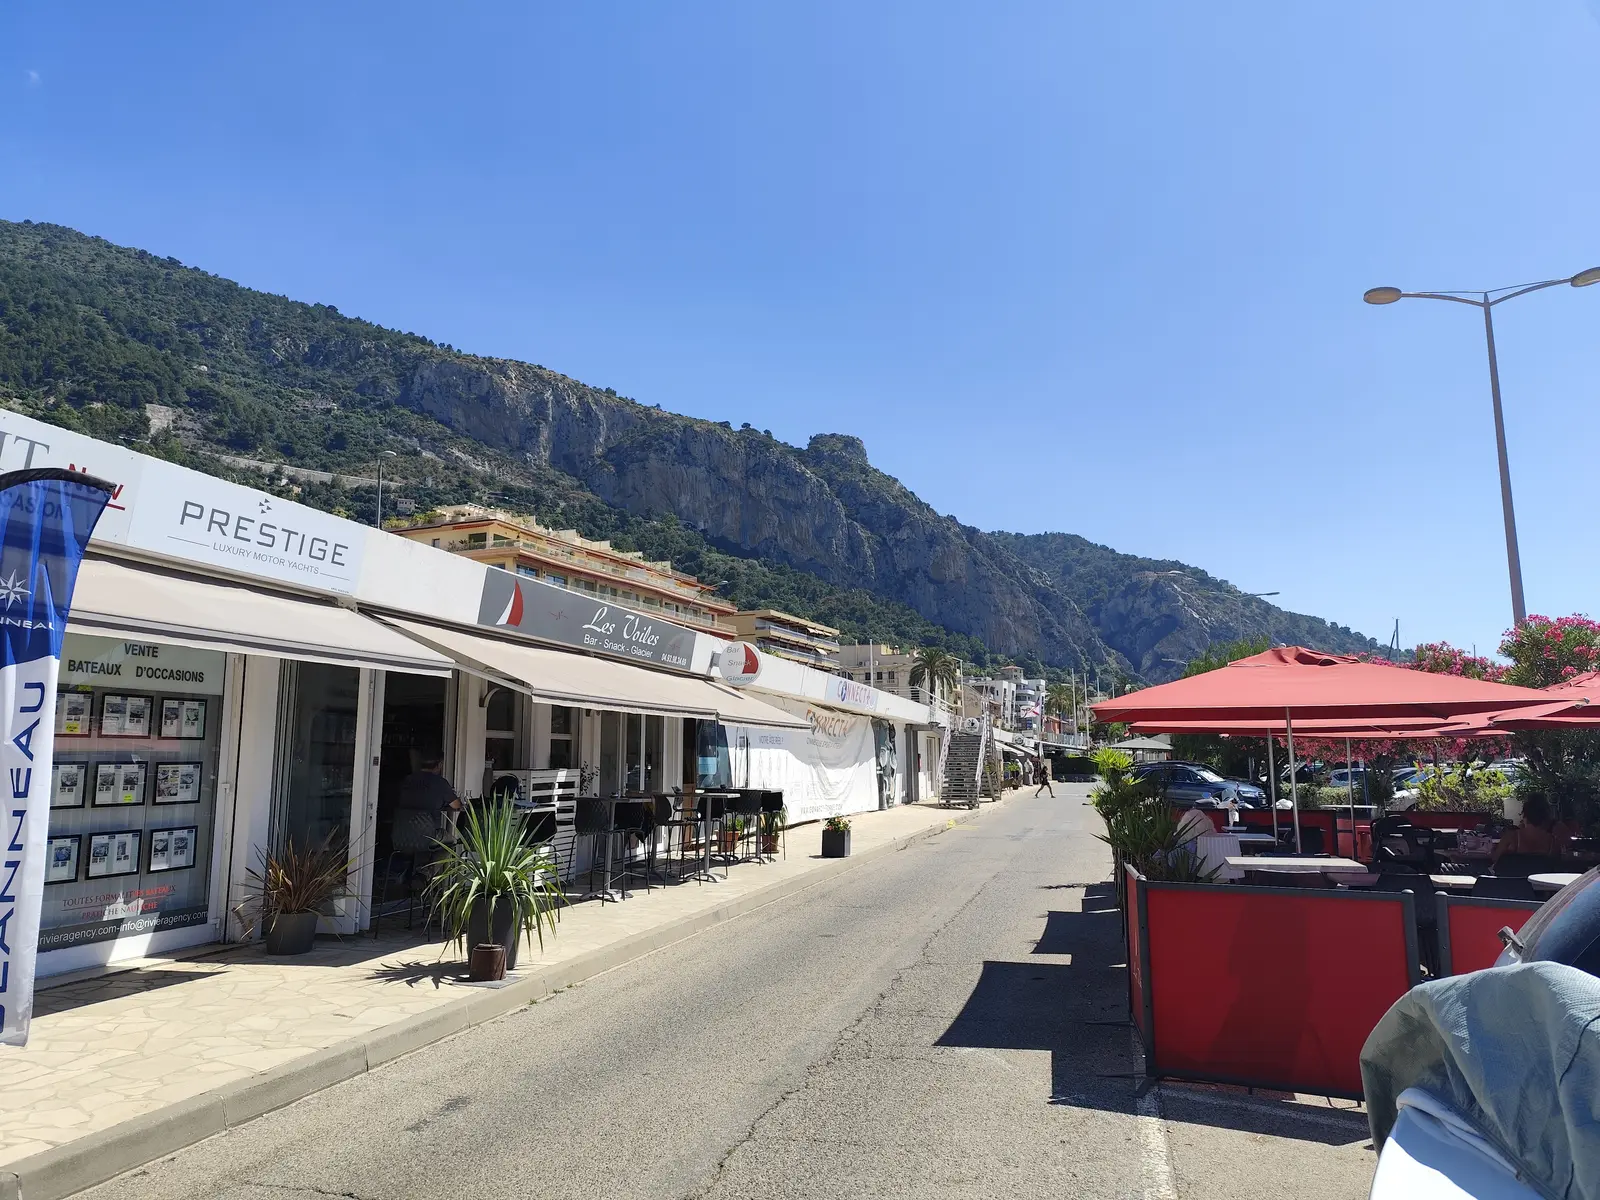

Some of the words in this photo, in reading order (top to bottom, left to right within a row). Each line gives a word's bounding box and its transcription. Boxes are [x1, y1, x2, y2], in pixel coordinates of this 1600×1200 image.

[180, 500, 349, 567] PRESTIGE
[213, 542, 252, 561] LUXURY
[253, 552, 285, 568] MOTOR
[287, 560, 320, 575] YACHTS
[582, 606, 616, 635] Les
[623, 614, 660, 646] Voiles
[124, 643, 159, 658] VENTE
[583, 634, 598, 646] Bar
[603, 639, 625, 652] Snack
[630, 645, 653, 658] Glacier
[726, 646, 740, 654] Bar
[68, 660, 122, 676] BATEAUX
[136, 666, 204, 683] D'OCCASIONS
[63, 896, 94, 907] TOUTES
